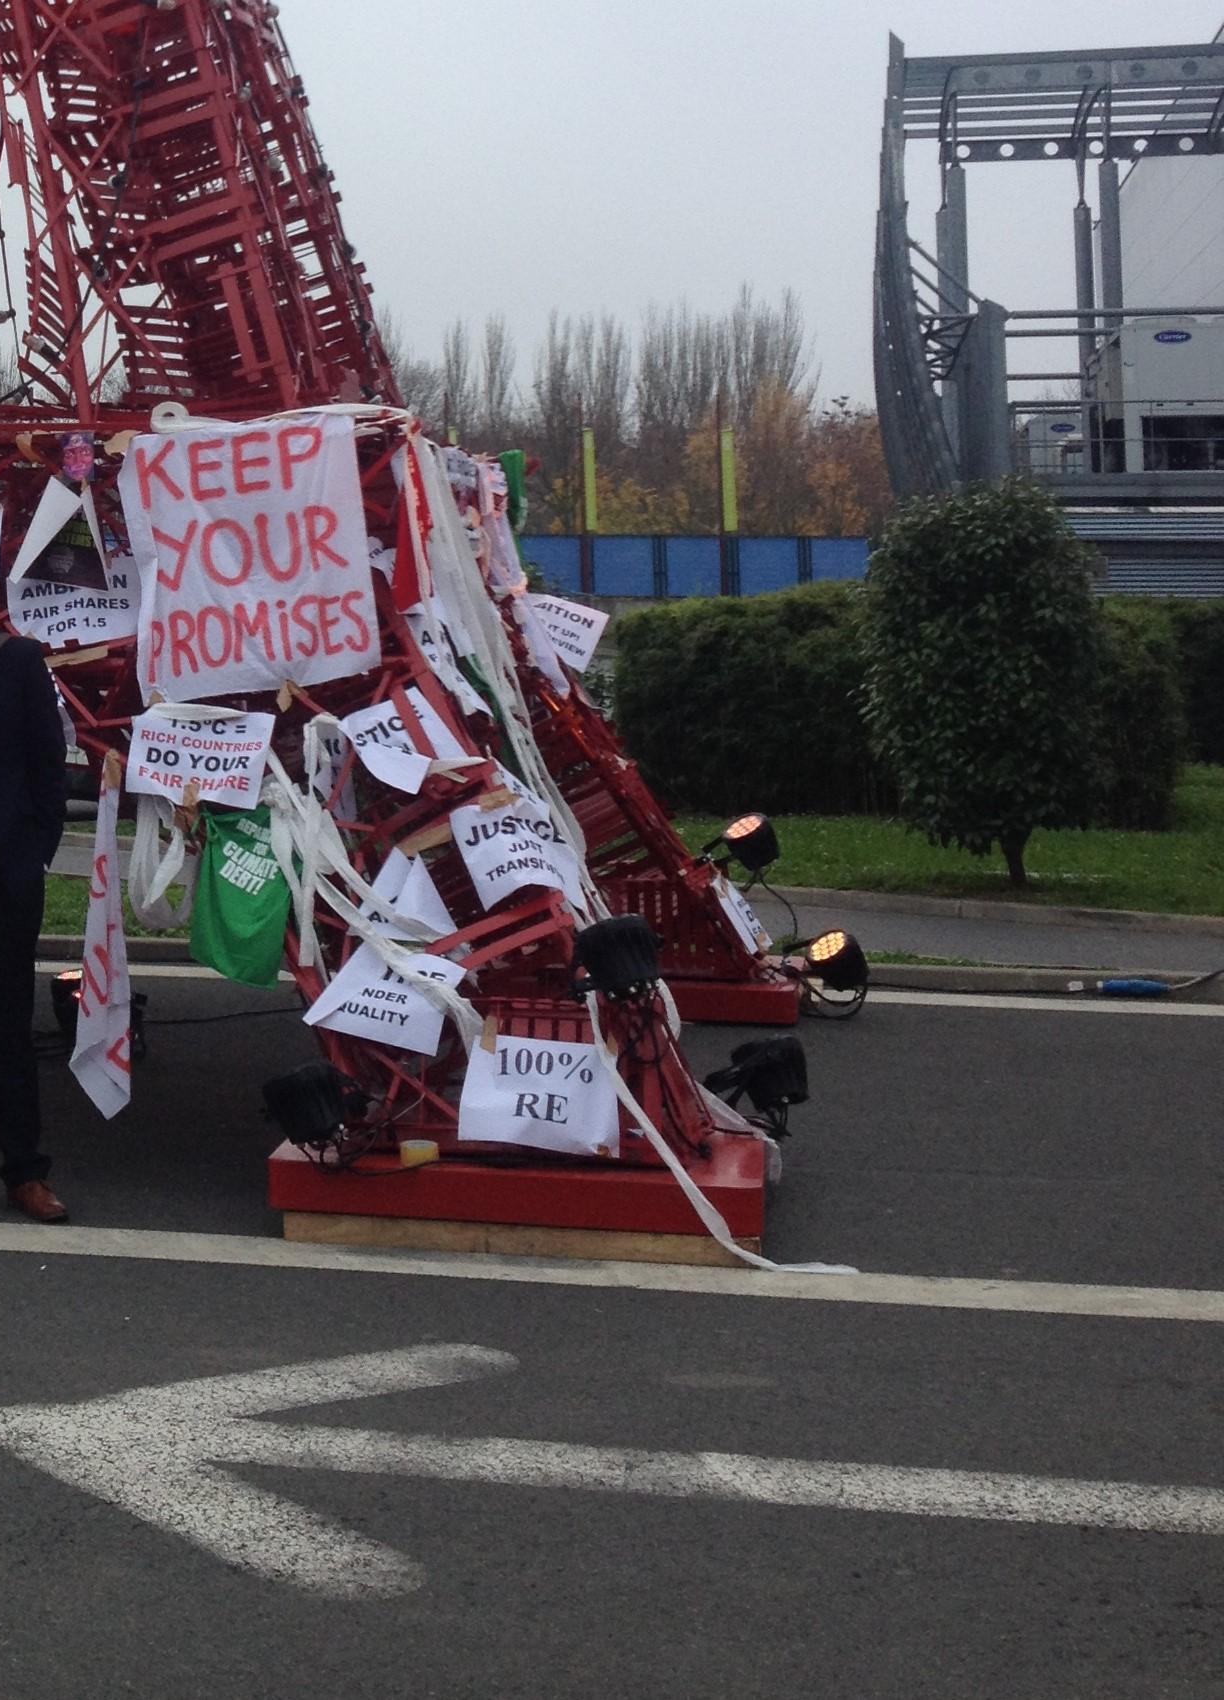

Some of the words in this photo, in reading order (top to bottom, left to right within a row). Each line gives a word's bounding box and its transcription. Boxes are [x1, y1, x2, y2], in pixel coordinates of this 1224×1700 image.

[135, 425, 322, 510] KEEP
[152, 505, 349, 591] YOUR
[21, 574, 128, 600] AMBN
[23, 605, 60, 622] FAIR
[64, 598, 129, 612] SHARES
[47, 617, 77, 636] FOR
[82, 617, 107, 628] 1.5
[140, 729, 176, 744] RICH
[181, 736, 264, 752] COUNTRIES
[145, 747, 180, 767] DO
[188, 753, 251, 772] YOUR
[138, 765, 184, 788] FAIR
[222, 840, 279, 880] CLIMATE
[486, 857, 565, 884] TRANSI
[219, 859, 266, 895] DEBT!
[361, 987, 408, 1005] NDER
[496, 1047, 594, 1085] 100%
[512, 1092, 569, 1125] RE
